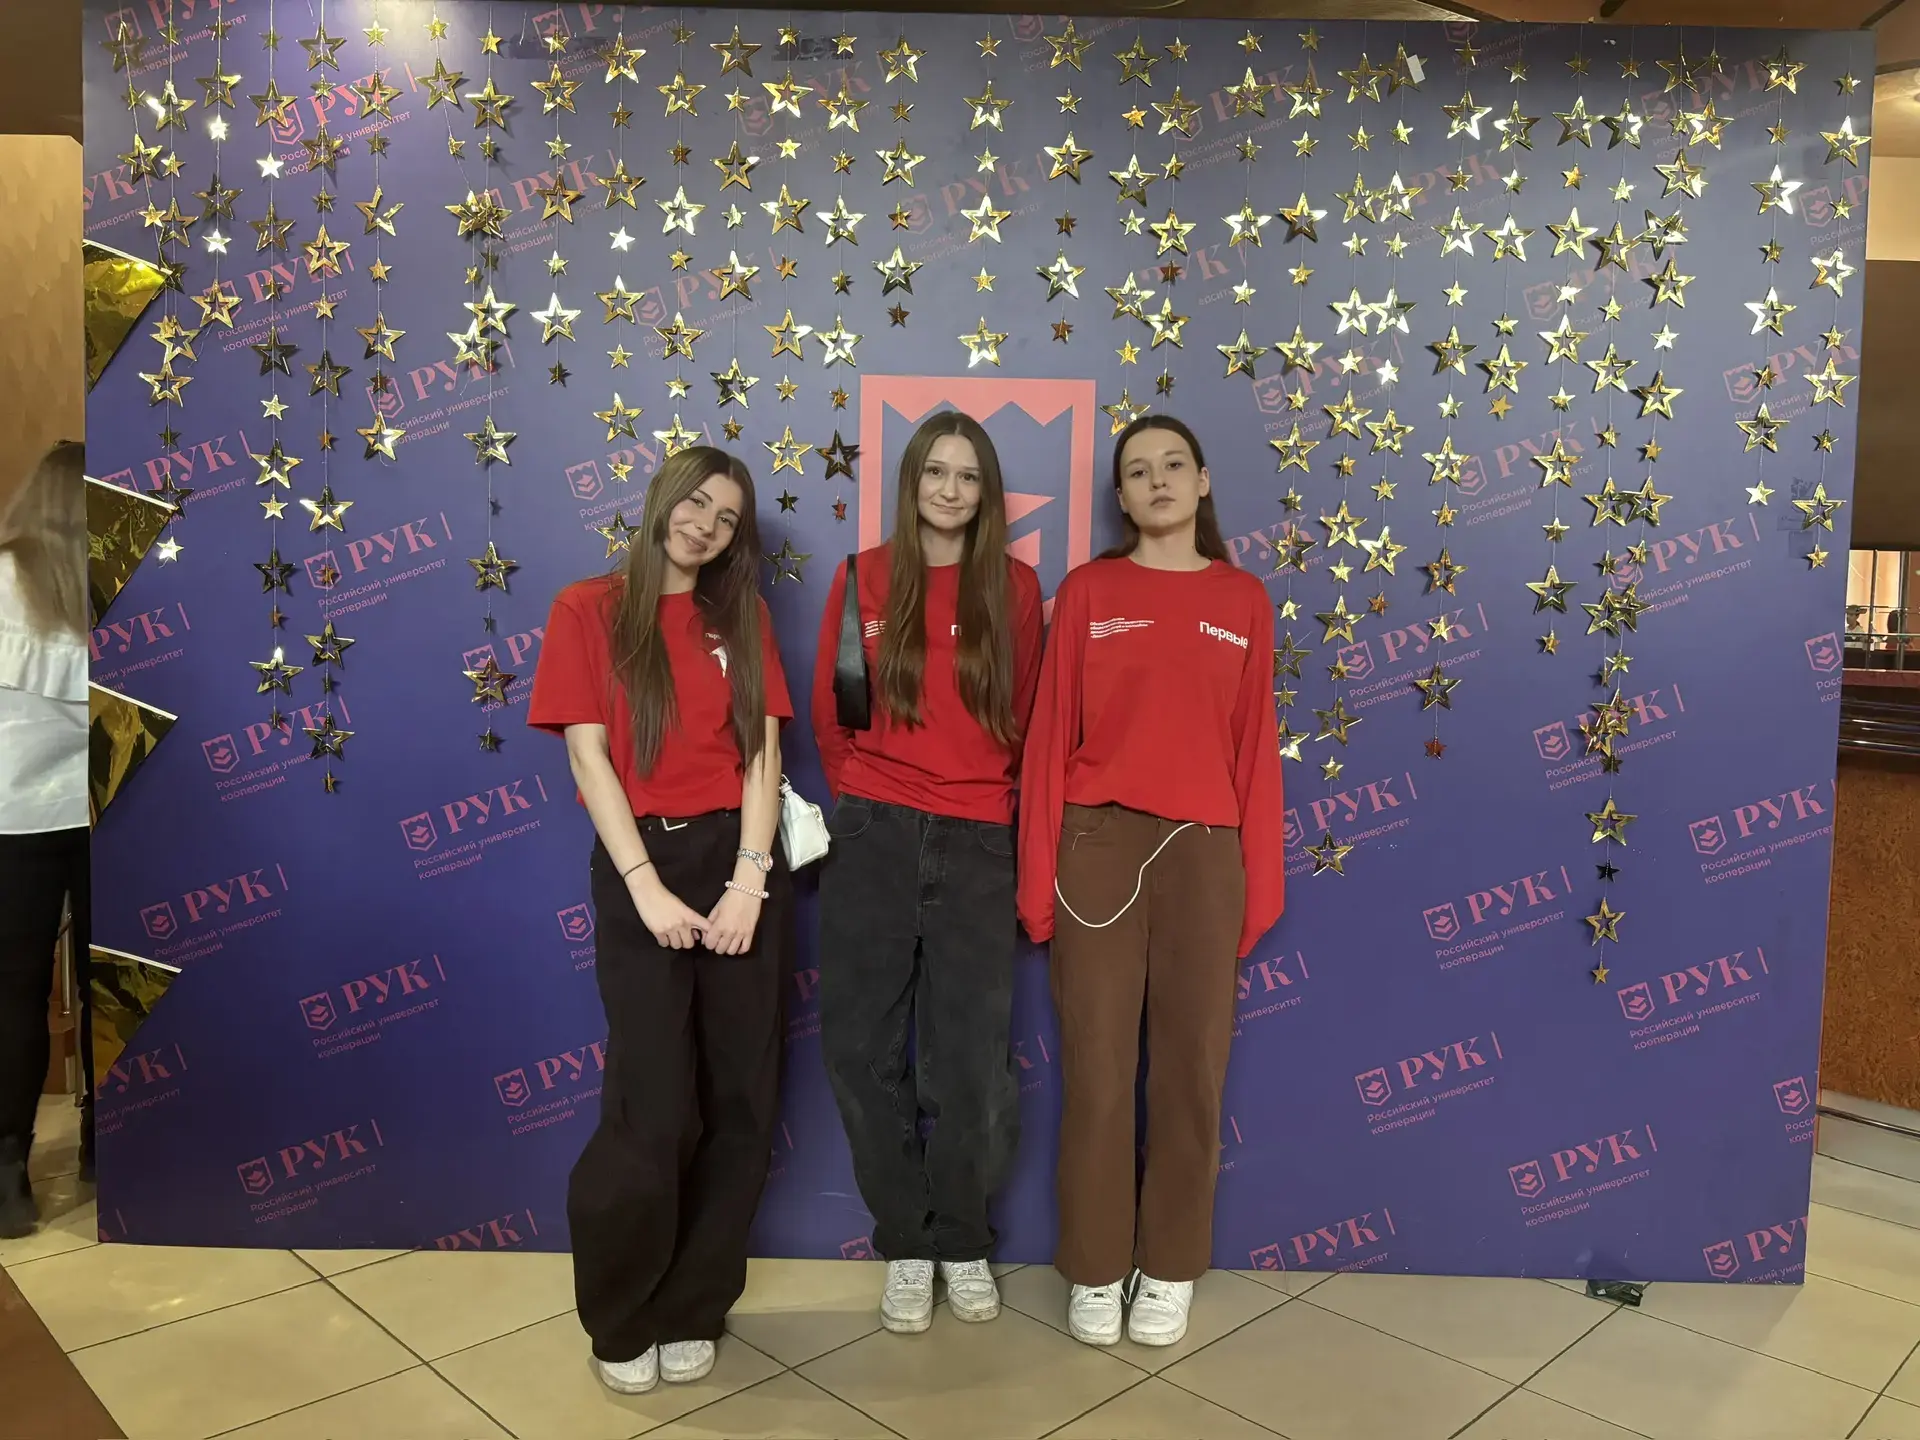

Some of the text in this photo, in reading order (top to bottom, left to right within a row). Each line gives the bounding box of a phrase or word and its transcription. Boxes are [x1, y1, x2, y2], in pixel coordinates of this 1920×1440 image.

[83, 162, 136, 211] УК
[511, 154, 605, 212] РУК
[671, 252, 765, 309] РУ
[218, 309, 283, 339] Российский
[393, 386, 509, 431] ссийский университет
[143, 434, 237, 490] РУК
[1492, 421, 1586, 477] РУК
[182, 476, 246, 506] университет
[578, 488, 642, 518] Российский
[1461, 483, 1527, 513] Российский
[1466, 497, 1532, 524] кооперации
[344, 516, 437, 572] РУК
[1649, 516, 1743, 573] РУК
[317, 558, 446, 607] Российский университет
[1260, 554, 1326, 584] универитет
[1685, 558, 1751, 588] университет
[322, 592, 386, 618] кооперации
[1200, 621, 1248, 649] Первые
[120, 647, 185, 676] университет
[1350, 648, 1481, 698] Российский униерситет
[1354, 685, 1412, 709] коопераци
[215, 760, 278, 789] Российский
[220, 774, 284, 800] кооперации
[1546, 751, 1603, 778] Российски
[1550, 767, 1602, 789] кооперац
[440, 780, 531, 834] РУК
[1310, 777, 1403, 831] РУК
[1732, 782, 1826, 837] РУК
[412, 820, 540, 868] Российский университет
[1346, 817, 1411, 846] университет
[417, 854, 480, 879] кооперации
[1701, 843, 1766, 872] Российский
[1705, 857, 1771, 883] кооперации
[180, 868, 272, 922] РУК
[1465, 870, 1557, 924] РУК
[153, 908, 281, 956] Российский университет
[1435, 911, 1565, 959] Российский университет
[1439, 944, 1504, 969] кооперации
[1660, 950, 1753, 1004] РУК
[337, 960, 429, 1013] РУК
[1235, 957, 1294, 1003] УК
[310, 999, 437, 1047] Российский университет
[1238, 997, 1302, 1026] университет
[1629, 991, 1761, 1038] Российский университет
[315, 1033, 378, 1058] кооперации
[1634, 1024, 1699, 1049] кооперации
[1395, 1036, 1487, 1090] РУК
[505, 1097, 567, 1125] Российский
[1366, 1076, 1495, 1123] Российский университет
[1370, 1109, 1434, 1134] кооперации
[509, 1110, 572, 1136] кооперации
[275, 1124, 366, 1177] РУК
[1549, 1129, 1641, 1182] РУК
[248, 1163, 375, 1211] Российский университет
[253, 1196, 316, 1222] кооперации
[1519, 1169, 1649, 1216] Российский университет
[1523, 1201, 1587, 1226] кооперации
[1288, 1213, 1379, 1266] РУК
